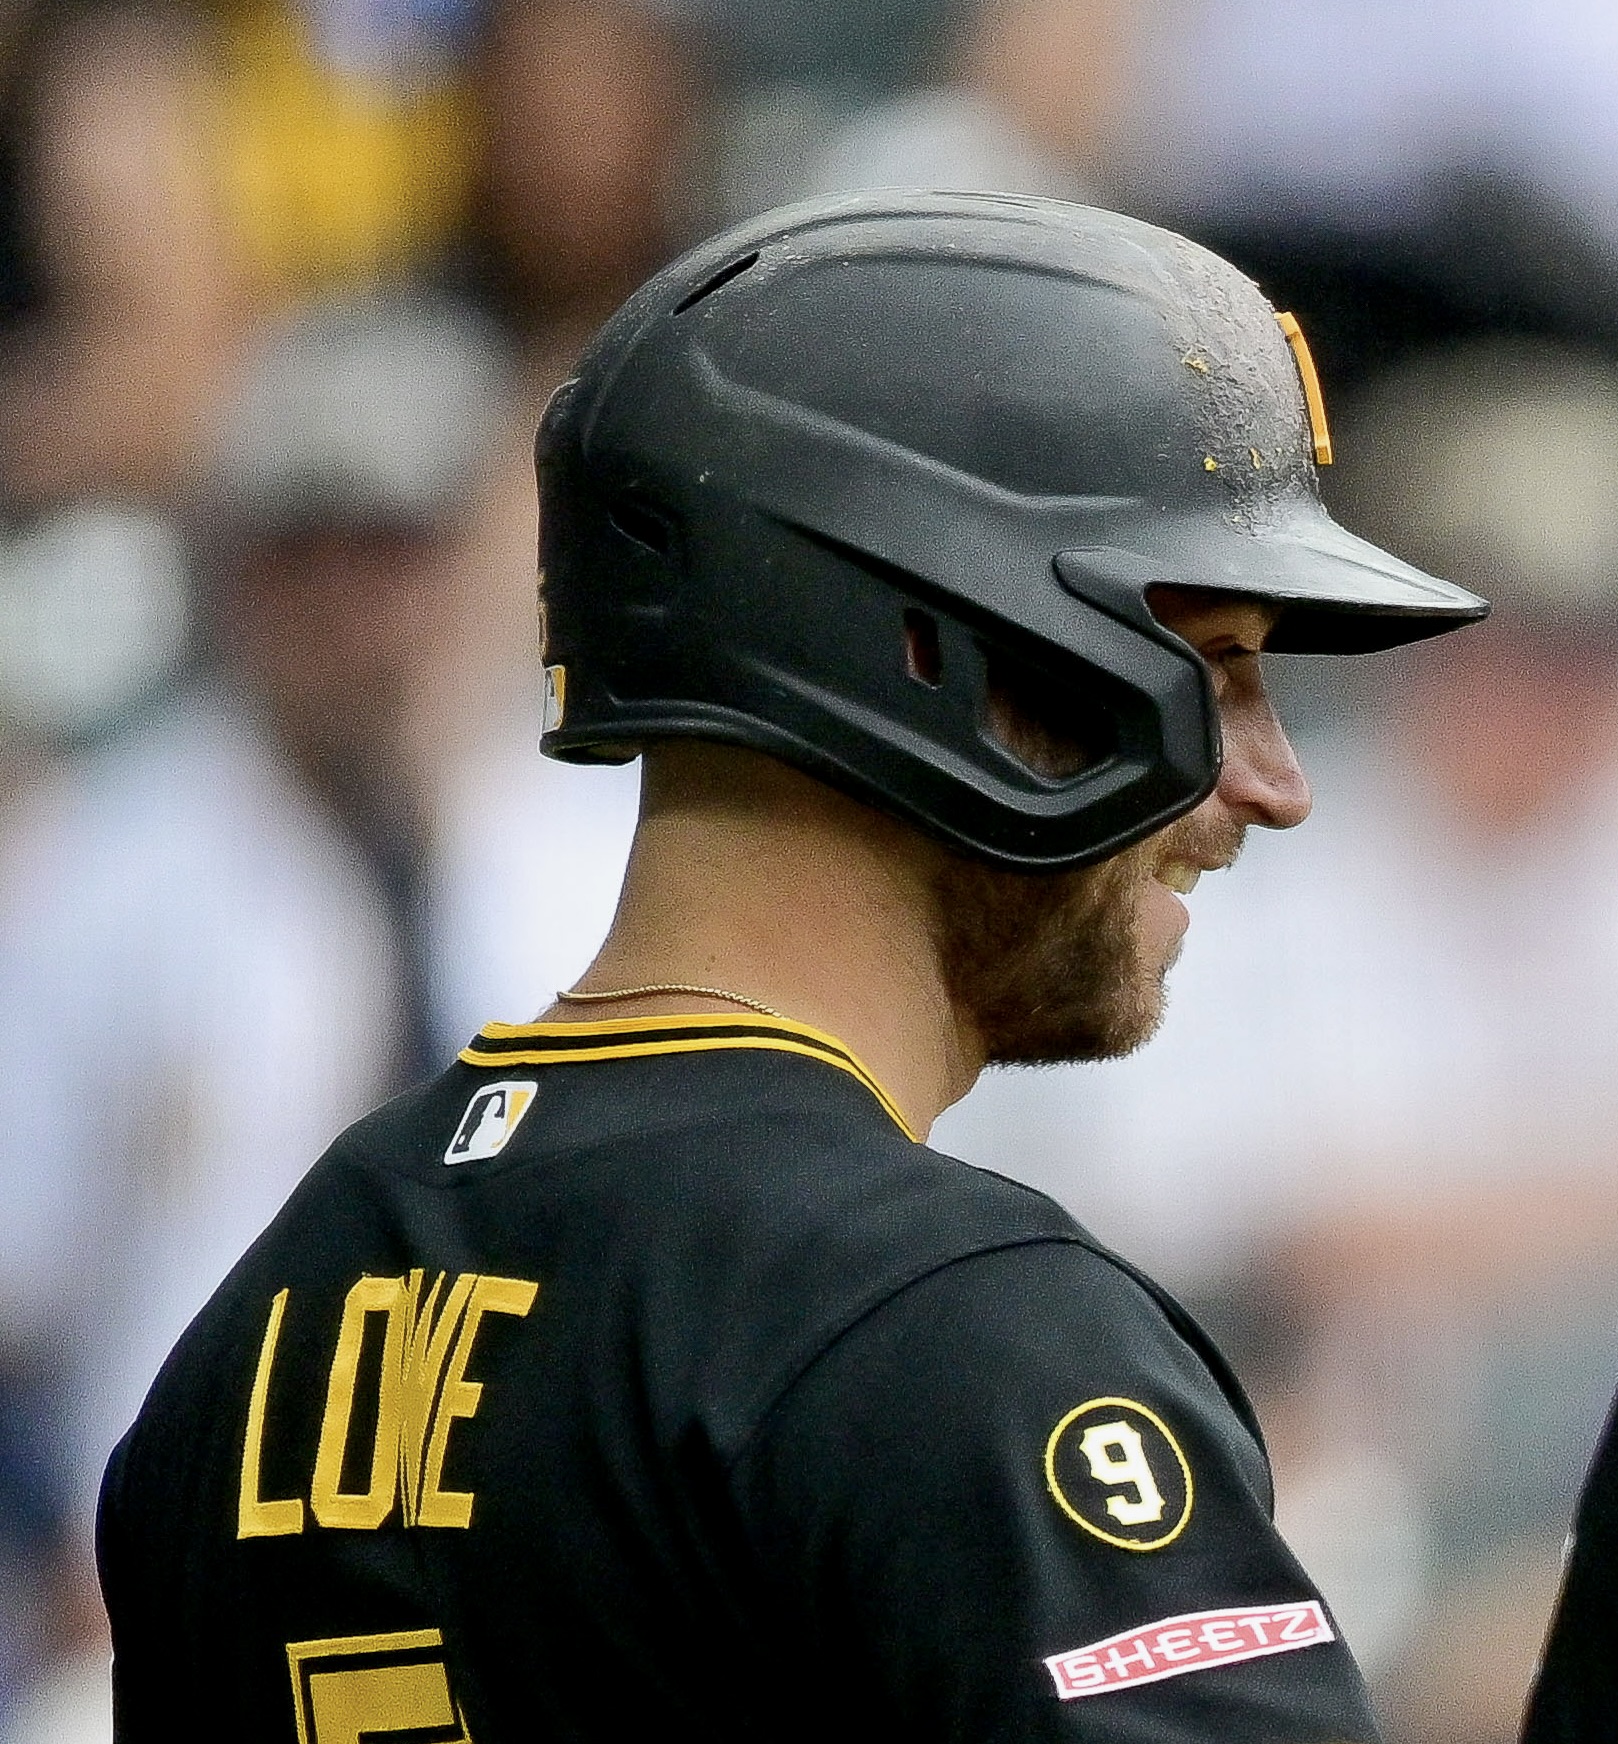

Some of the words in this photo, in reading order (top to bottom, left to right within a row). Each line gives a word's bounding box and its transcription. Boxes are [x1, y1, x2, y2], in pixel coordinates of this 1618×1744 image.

[237, 1268, 540, 1539] LOWE
[1079, 1420, 1166, 1525] 9
[1062, 1609, 1317, 1689] SHEETZ
